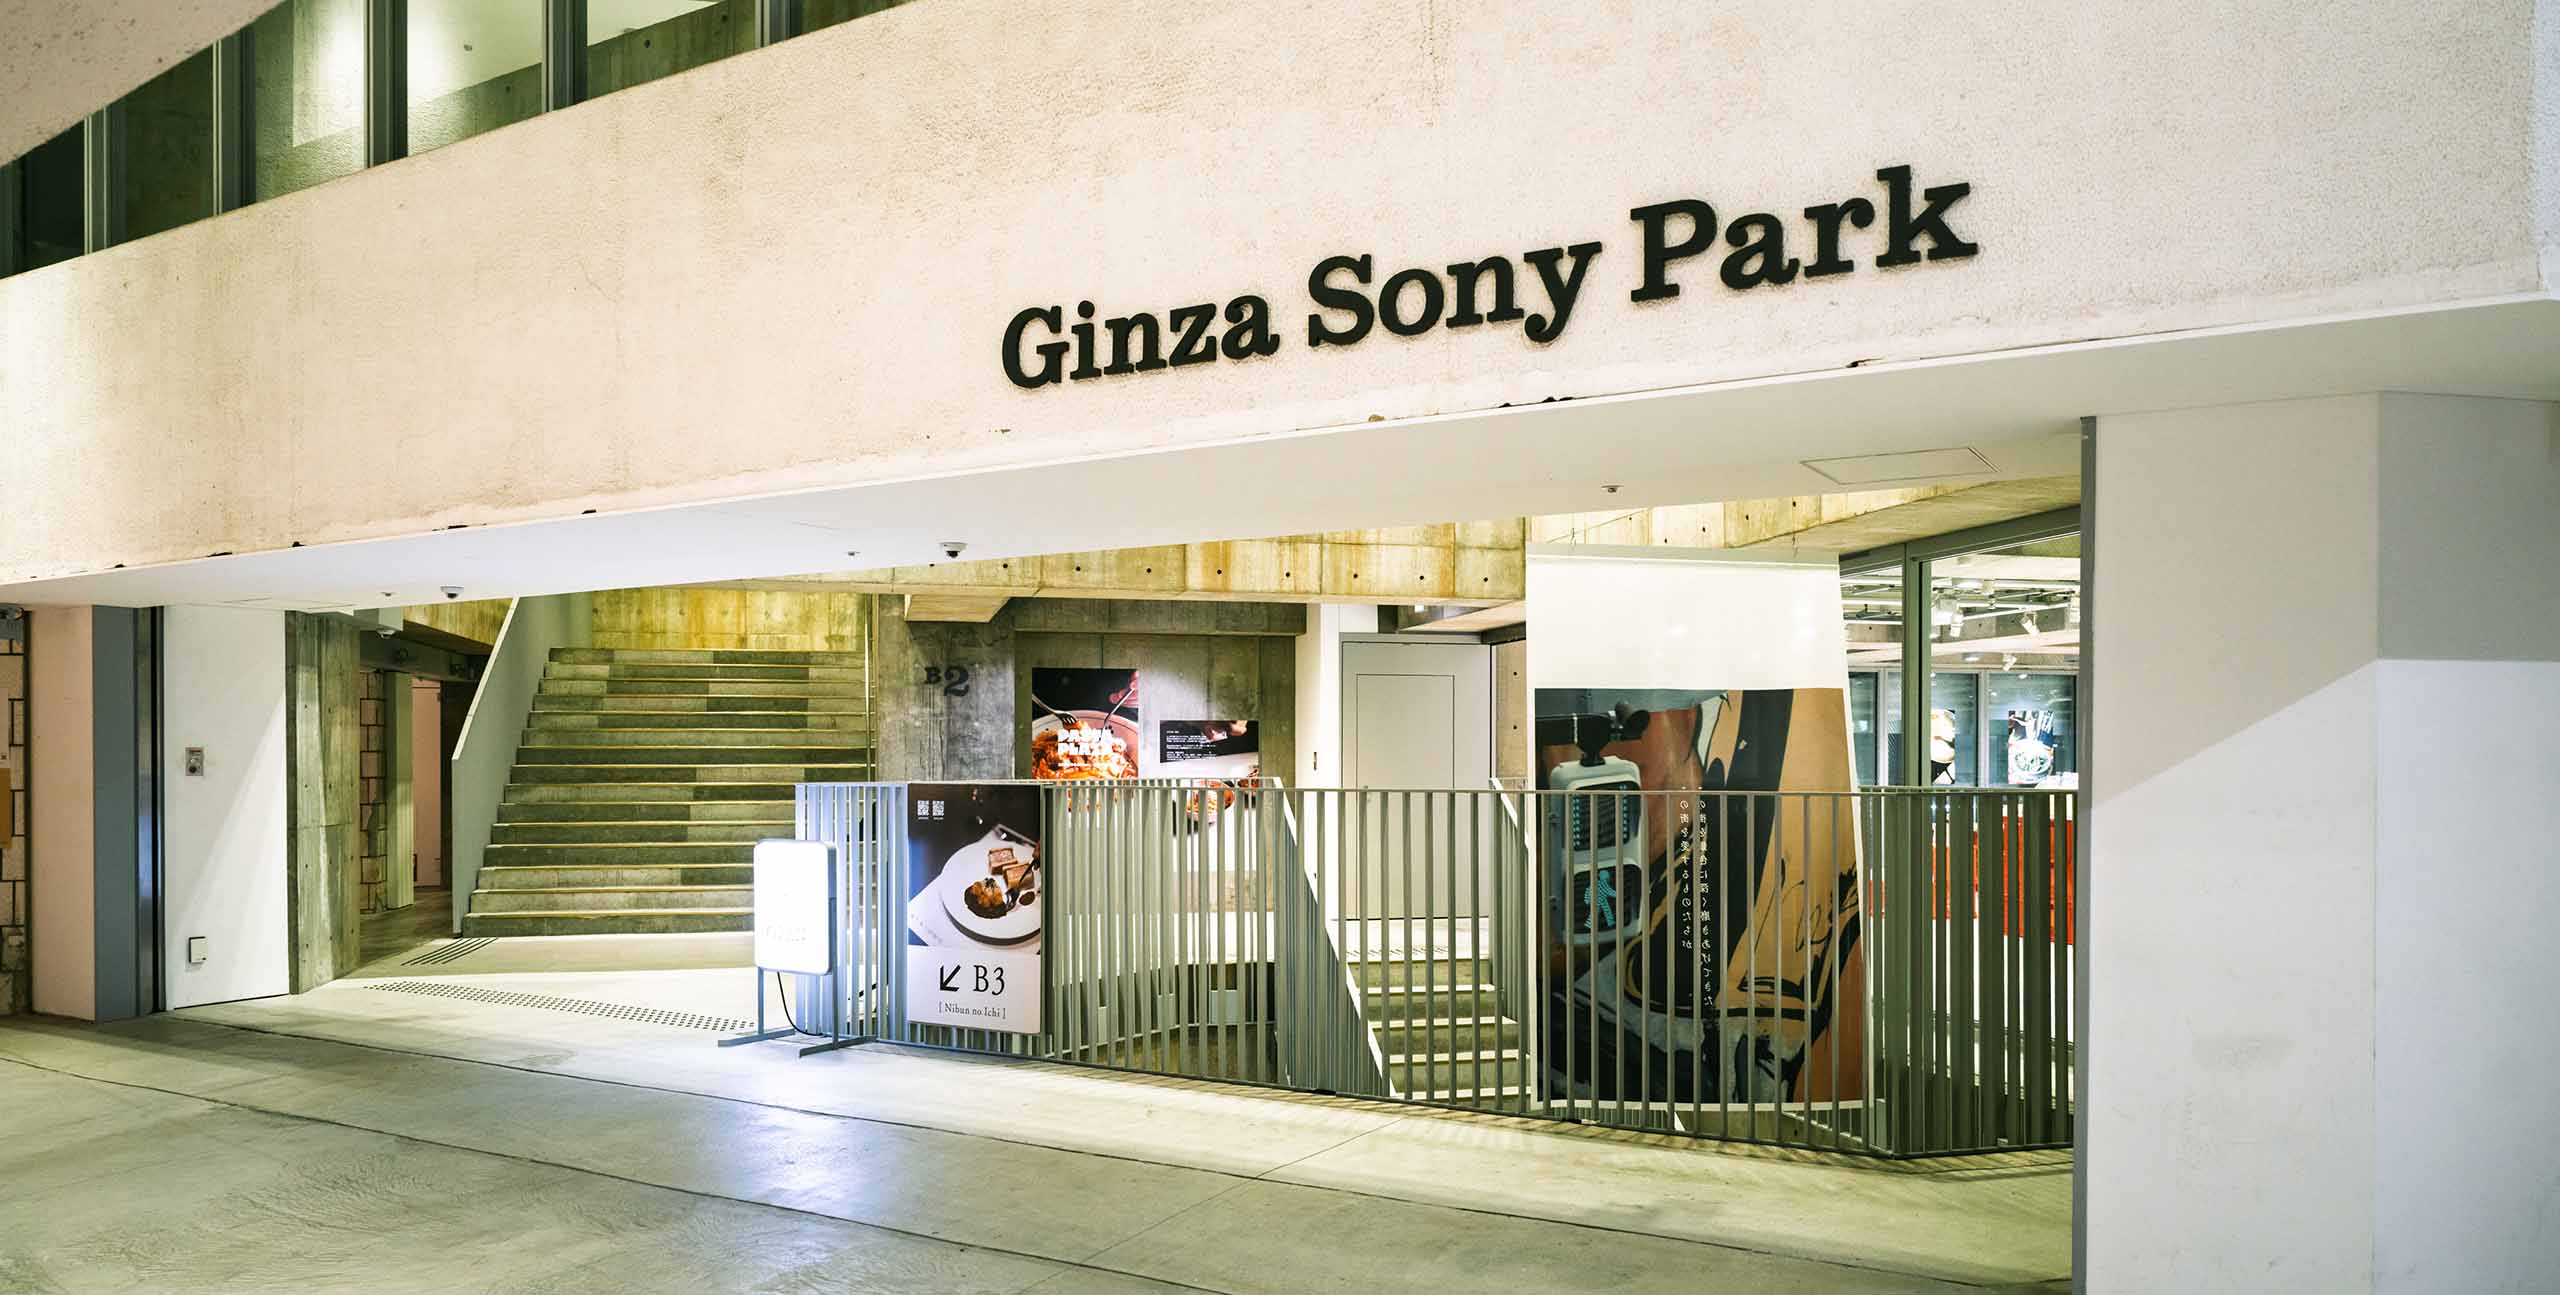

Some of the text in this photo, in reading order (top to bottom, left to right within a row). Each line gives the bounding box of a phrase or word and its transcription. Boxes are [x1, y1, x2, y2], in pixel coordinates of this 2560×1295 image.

[1001, 164, 1979, 389] Ginza Sony Park
[924, 666, 969, 697] B2
[973, 965, 1005, 996] B3
[972, 1007, 982, 1016] no
